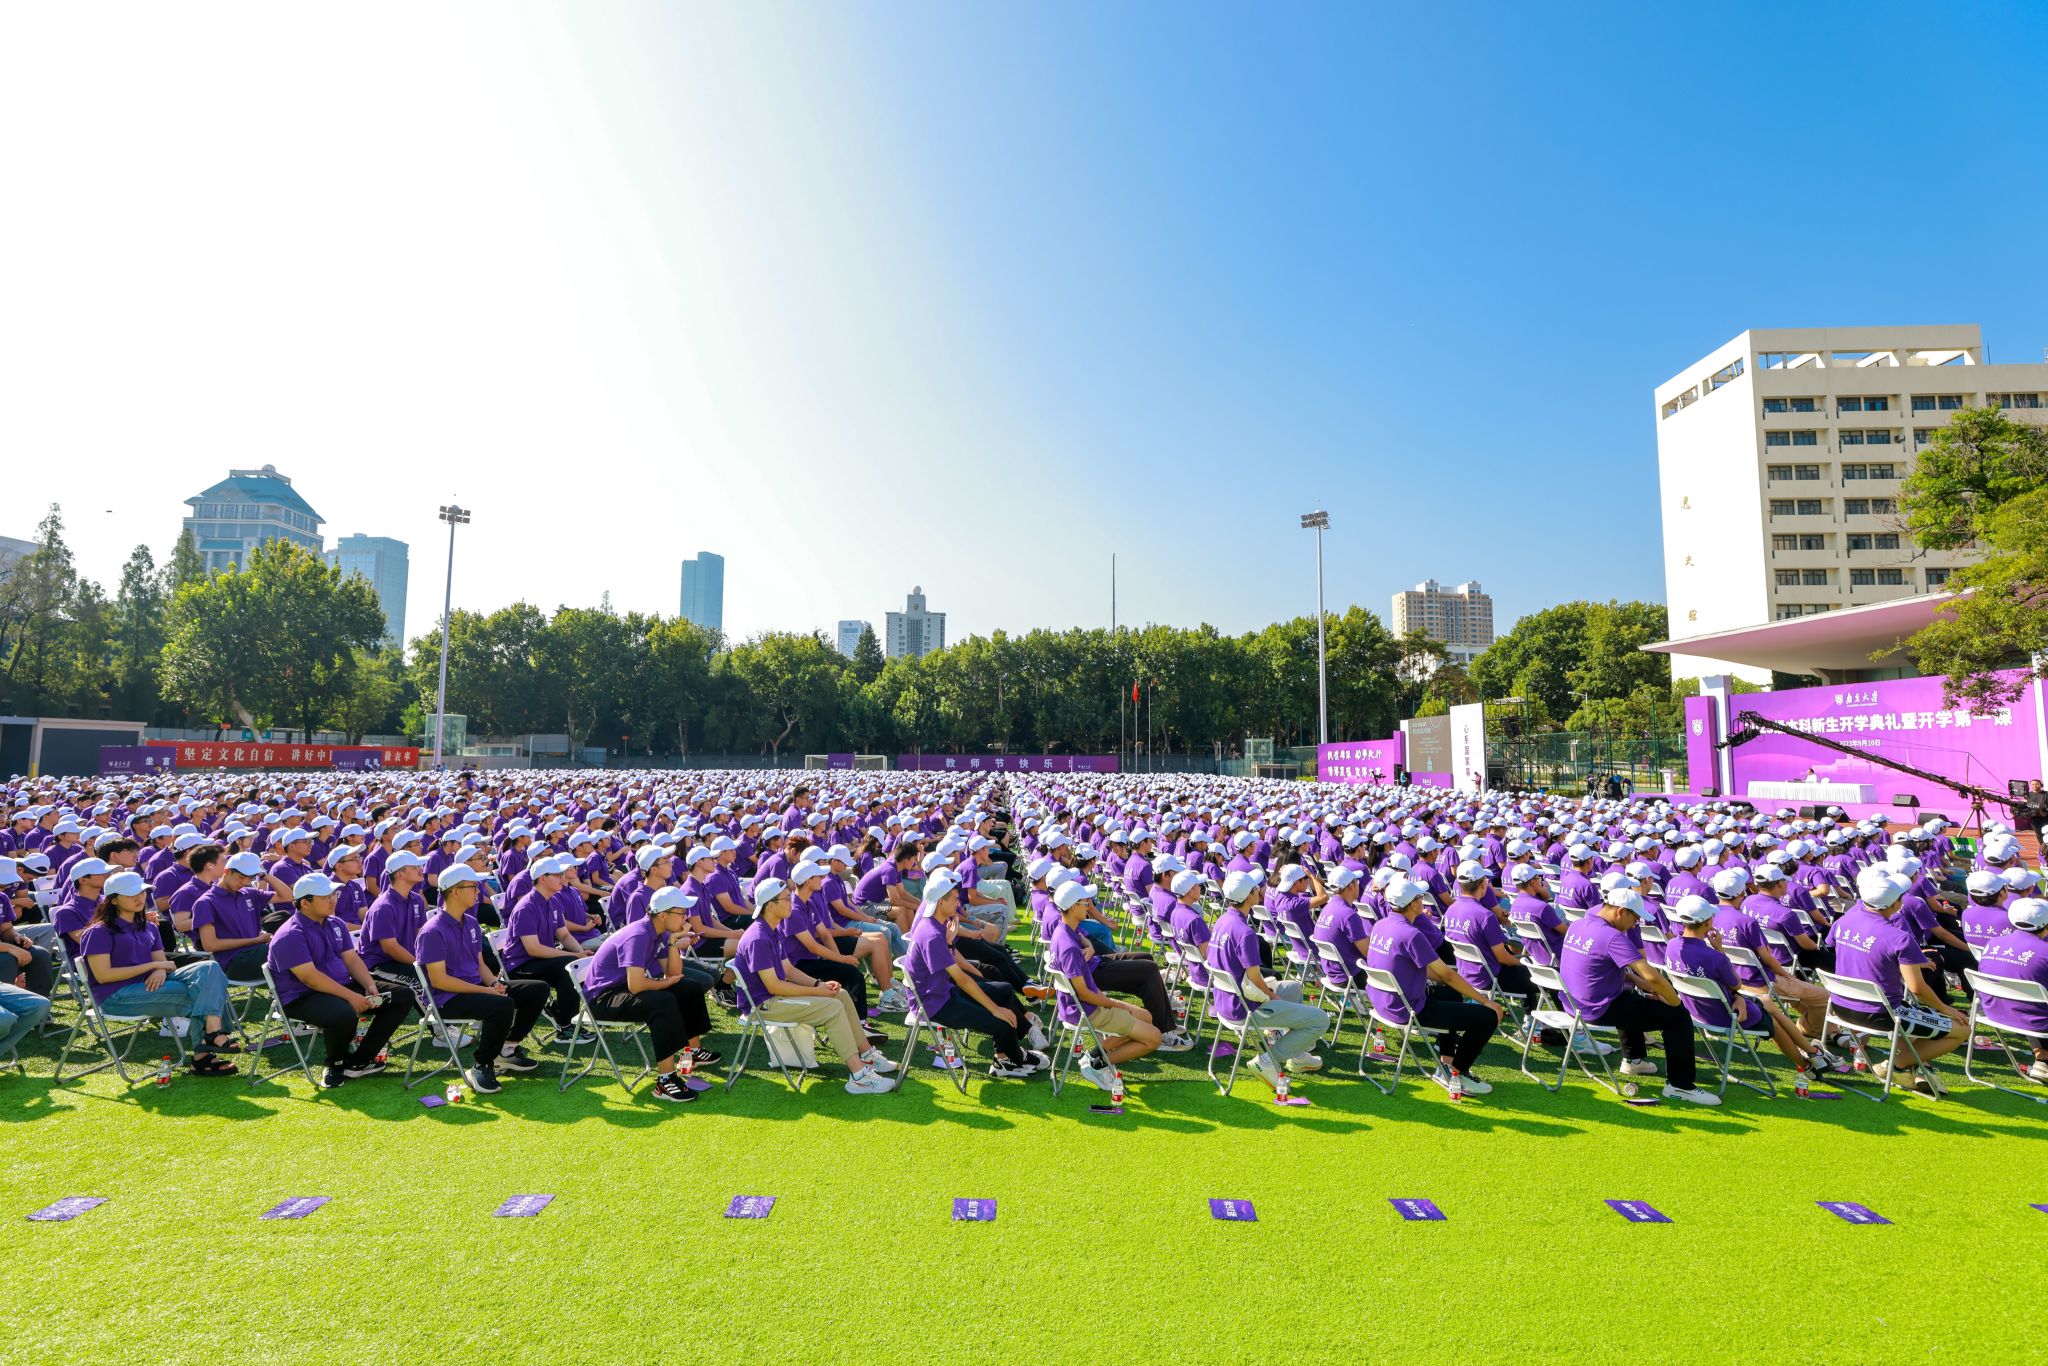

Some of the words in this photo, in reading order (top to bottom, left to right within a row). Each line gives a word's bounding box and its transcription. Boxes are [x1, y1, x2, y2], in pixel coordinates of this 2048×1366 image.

[1745, 707, 2012, 735] 23级本科新生开学典礼暨开学第一课
[175, 747, 333, 762] 坚定文化自信、讲好中
[945, 758, 1071, 768] 教师节快乐
